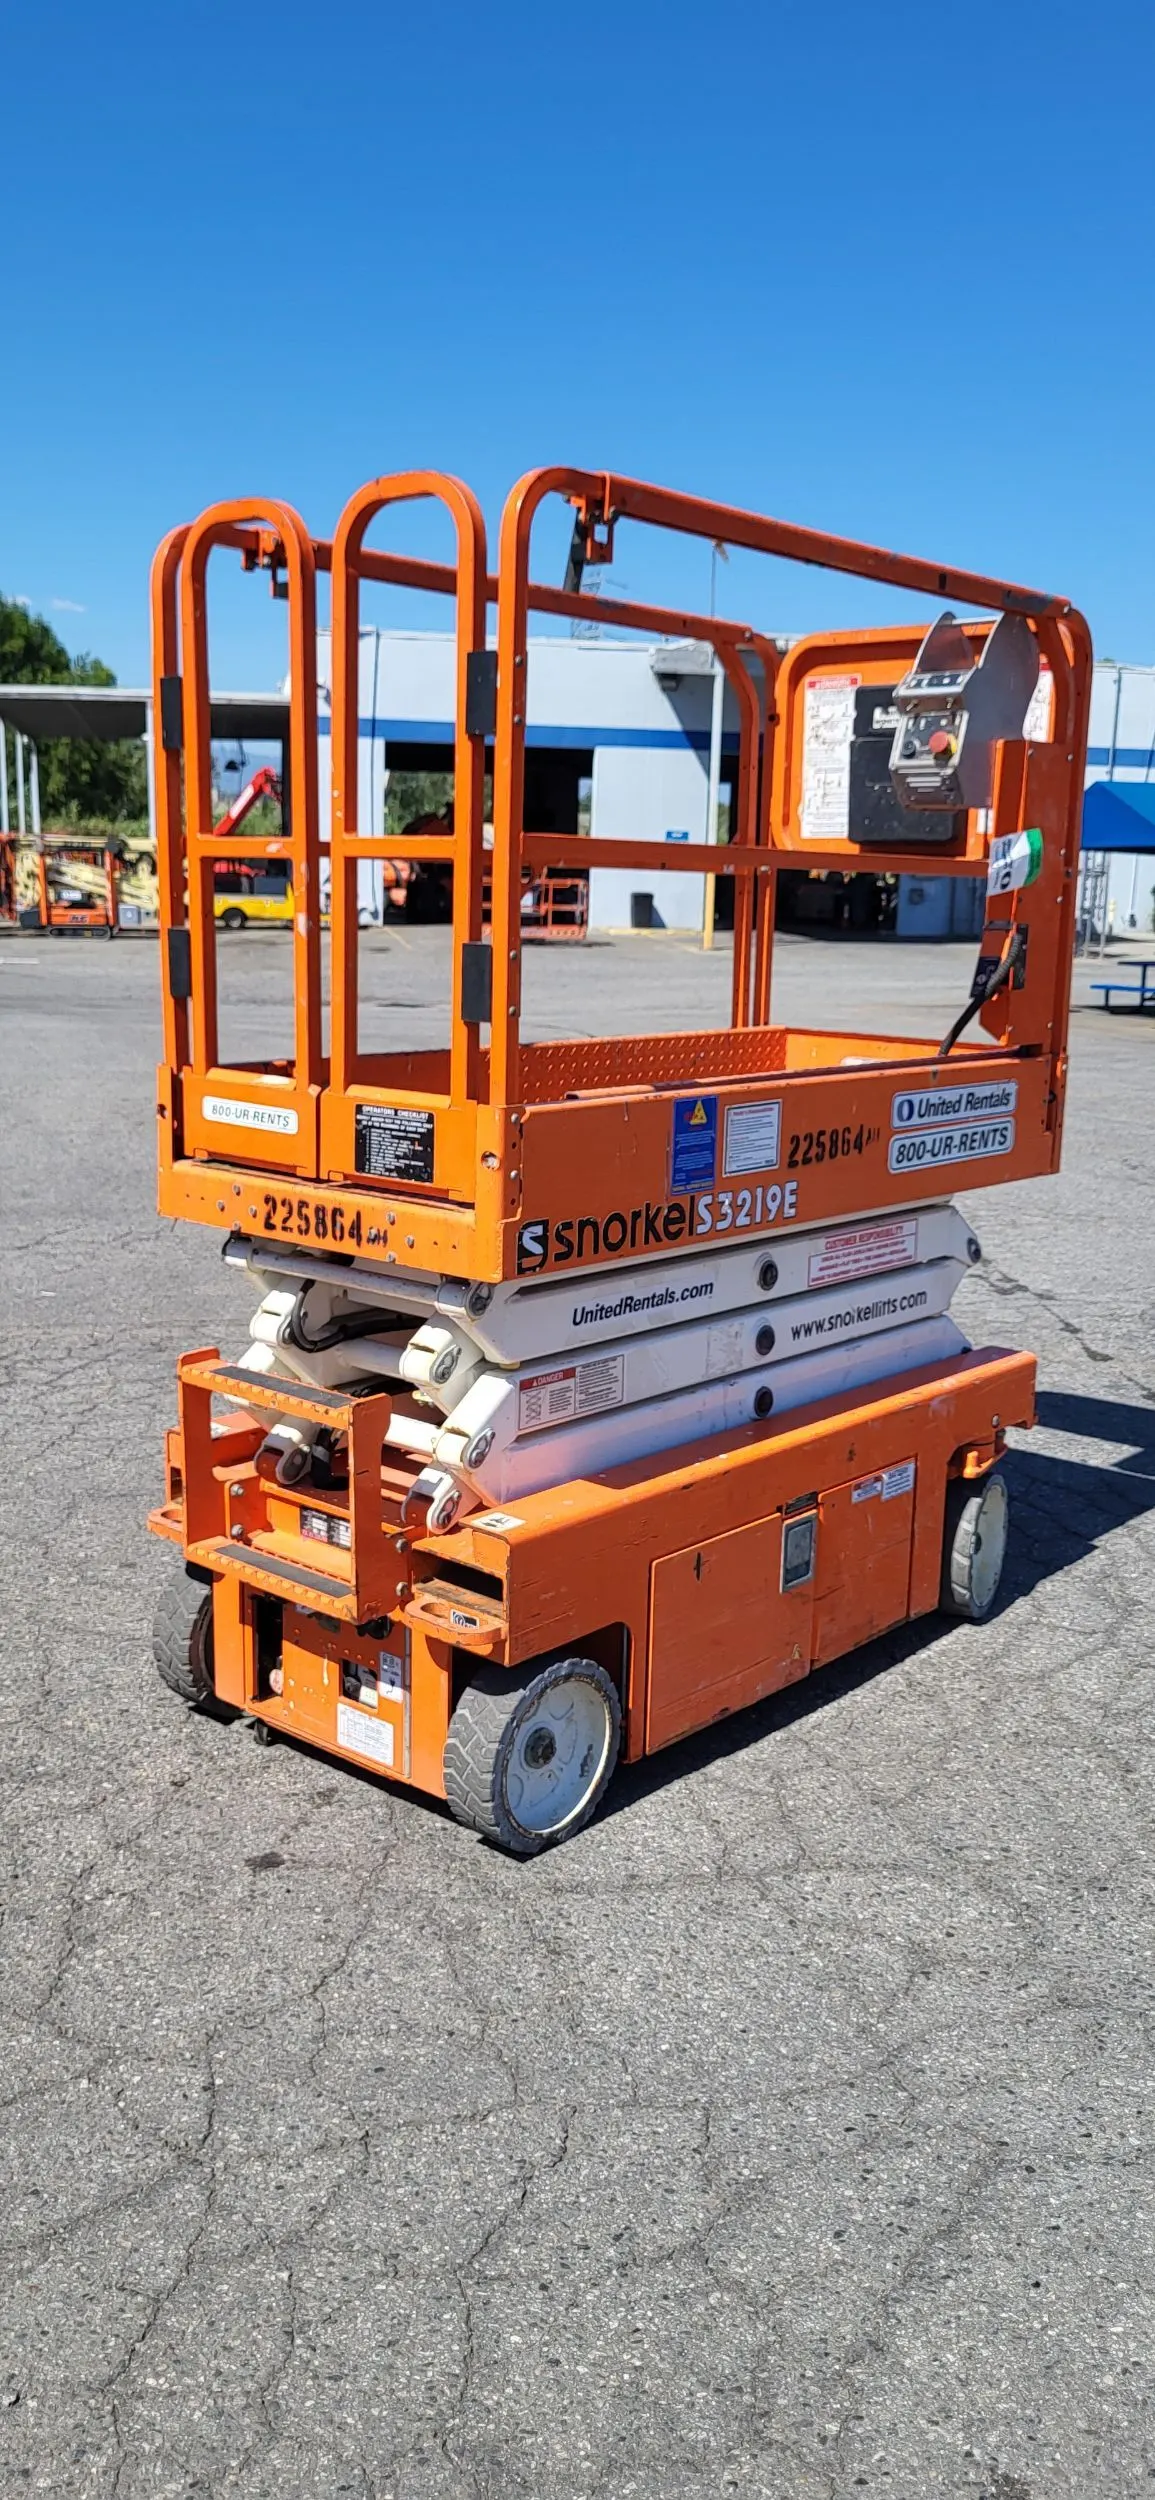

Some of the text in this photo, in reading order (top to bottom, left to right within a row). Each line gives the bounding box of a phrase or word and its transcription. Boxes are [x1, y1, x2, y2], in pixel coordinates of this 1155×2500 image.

[917, 1087, 1011, 1119] United Rentals
[895, 1126, 1009, 1165] 800-UR-RENTS
[553, 1195, 696, 1263] snorkel
[696, 1180, 799, 1236] S3219E
[572, 1281, 715, 1327] UnitedRentals.com
[790, 1290, 928, 1342] www.snorkelliftscom
[537, 1371, 564, 1386] DANGER
